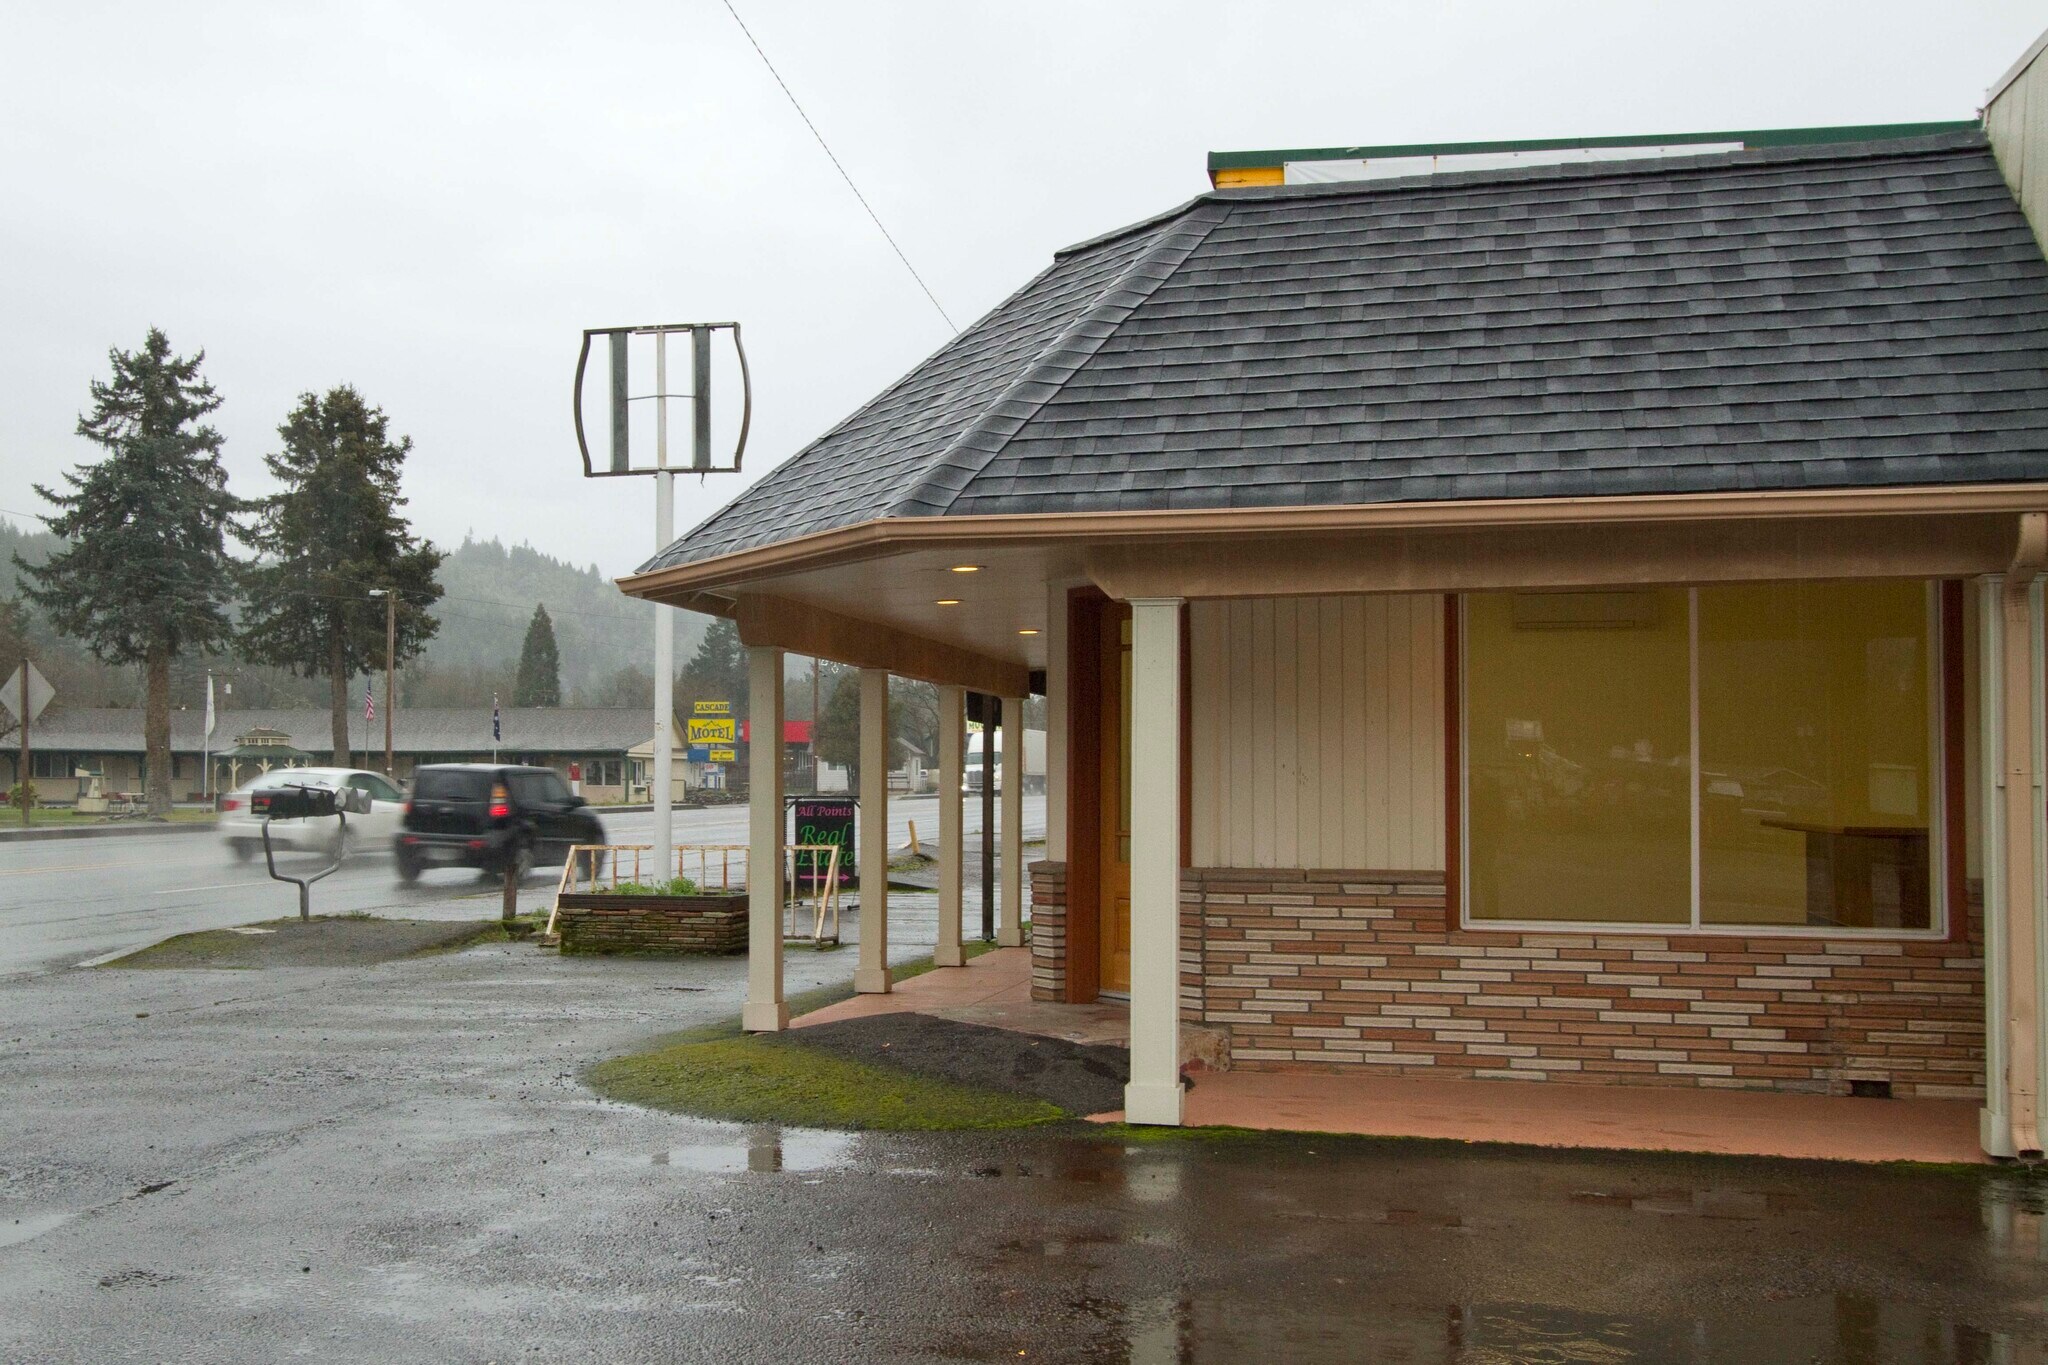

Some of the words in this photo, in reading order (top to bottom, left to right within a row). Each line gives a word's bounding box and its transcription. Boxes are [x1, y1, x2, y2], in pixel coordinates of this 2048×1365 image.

[695, 703, 729, 711] CASCADE
[690, 725, 733, 741] MOTEL
[796, 805, 817, 817] All
[817, 806, 853, 817] Points
[800, 822, 852, 846] Real
